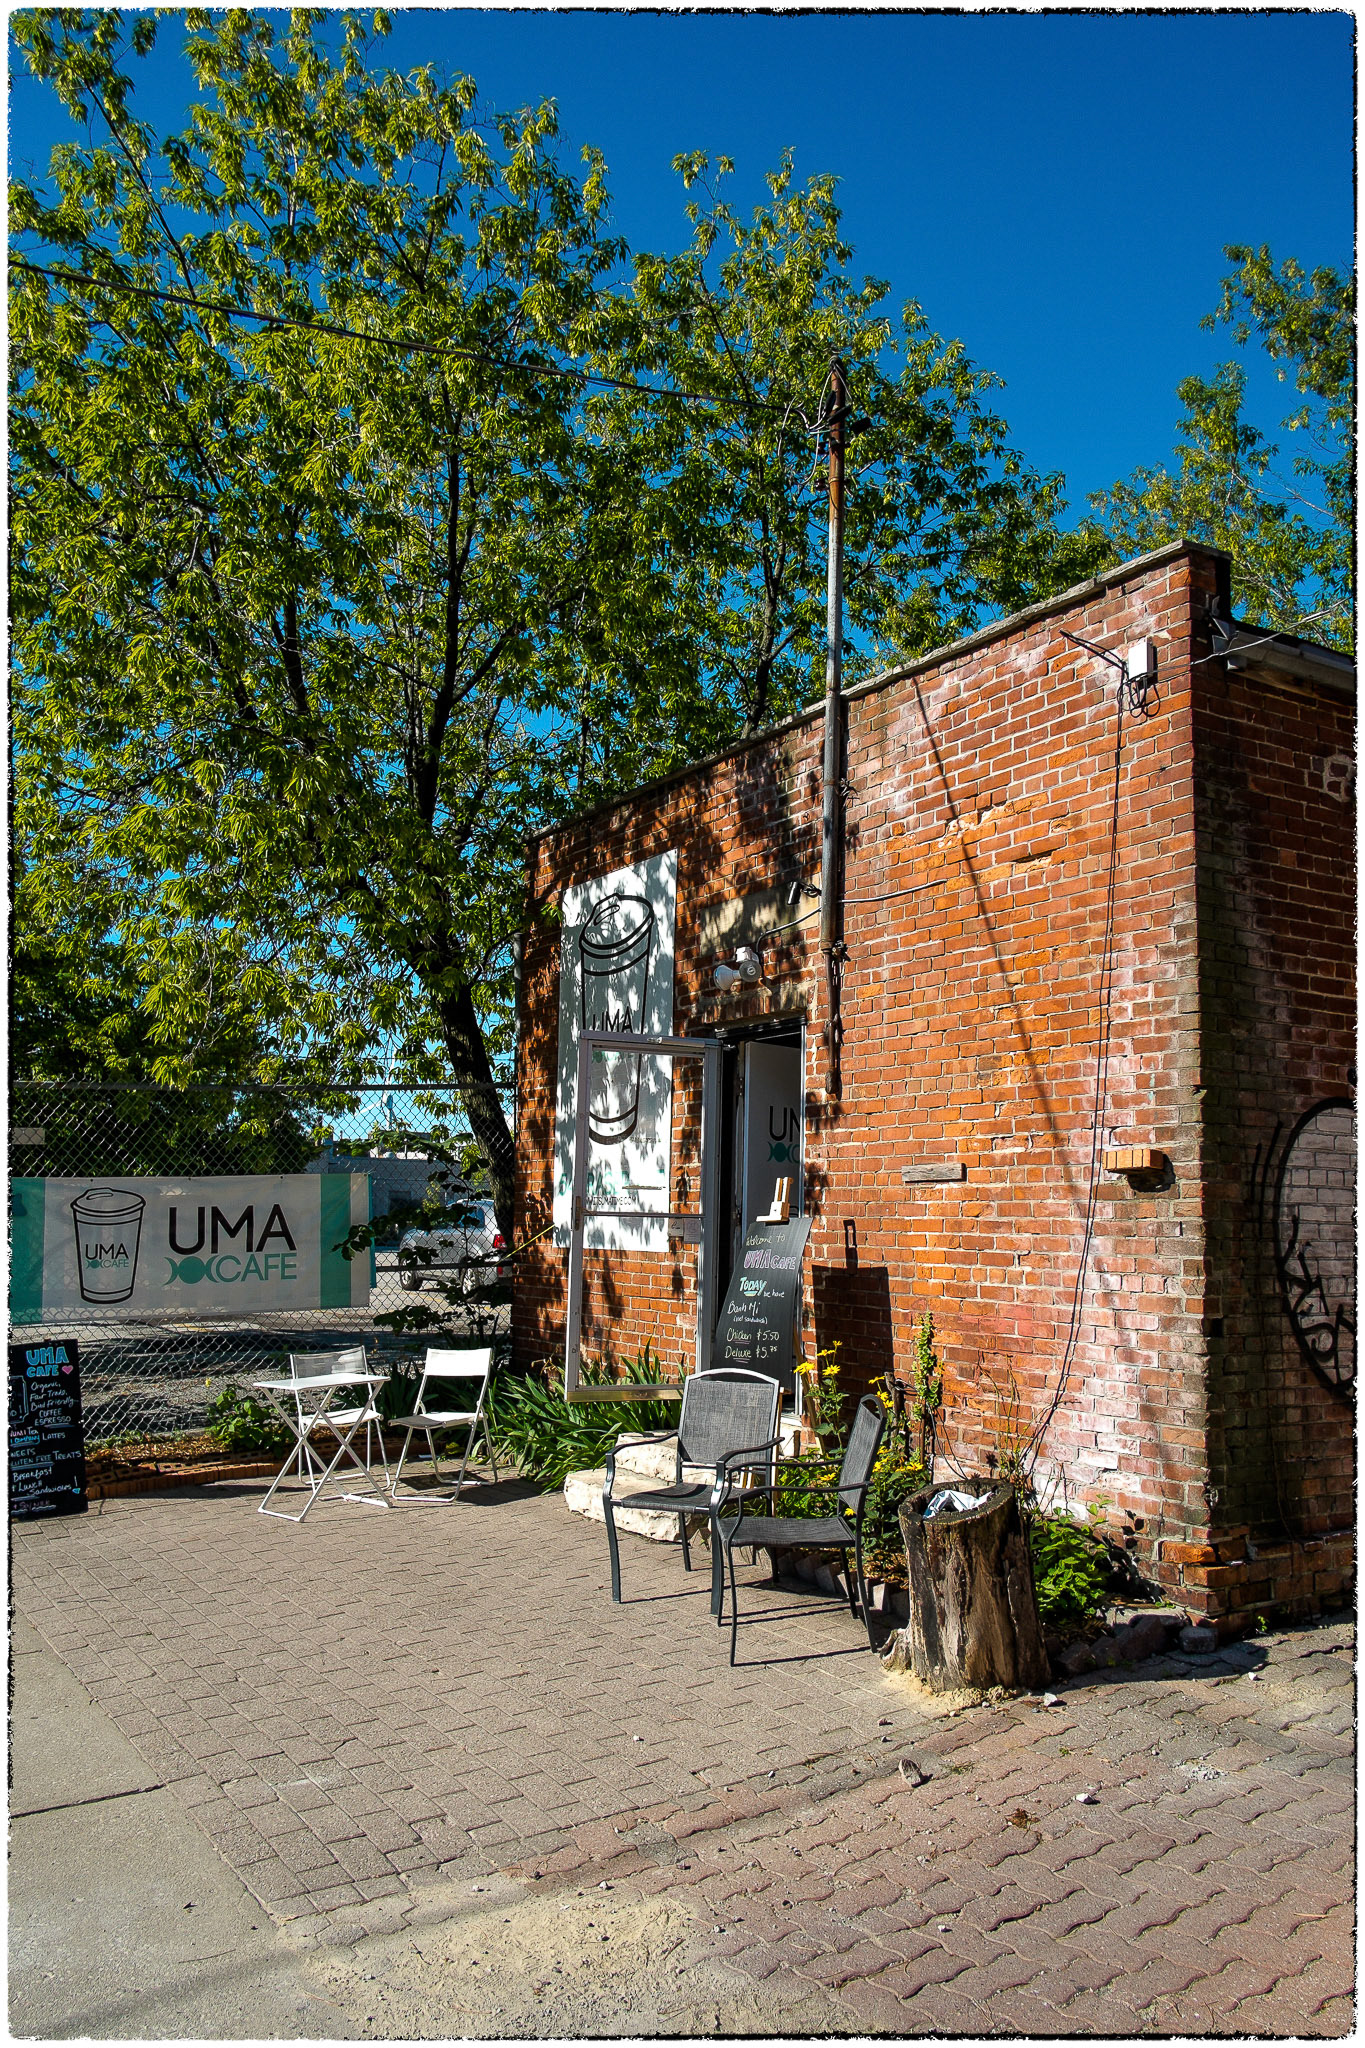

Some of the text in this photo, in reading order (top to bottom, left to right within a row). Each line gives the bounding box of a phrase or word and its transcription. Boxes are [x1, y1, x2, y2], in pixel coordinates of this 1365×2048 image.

[168, 1203, 297, 1255] UMA
[776, 1233, 786, 1243] to
[85, 1243, 129, 1260] UMA
[103, 1258, 129, 1269] CAFE
[744, 1249, 796, 1270] UMA CAFE
[216, 1253, 298, 1283] CAFE
[726, 1327, 780, 1342] Chicken $5.50
[26, 1346, 70, 1365] UMA
[724, 1345, 752, 1358] Deluxe
[26, 1364, 59, 1377] CAFE
[39, 1408, 63, 1417] COFFEE
[35, 1416, 71, 1427] ESPRESSO
